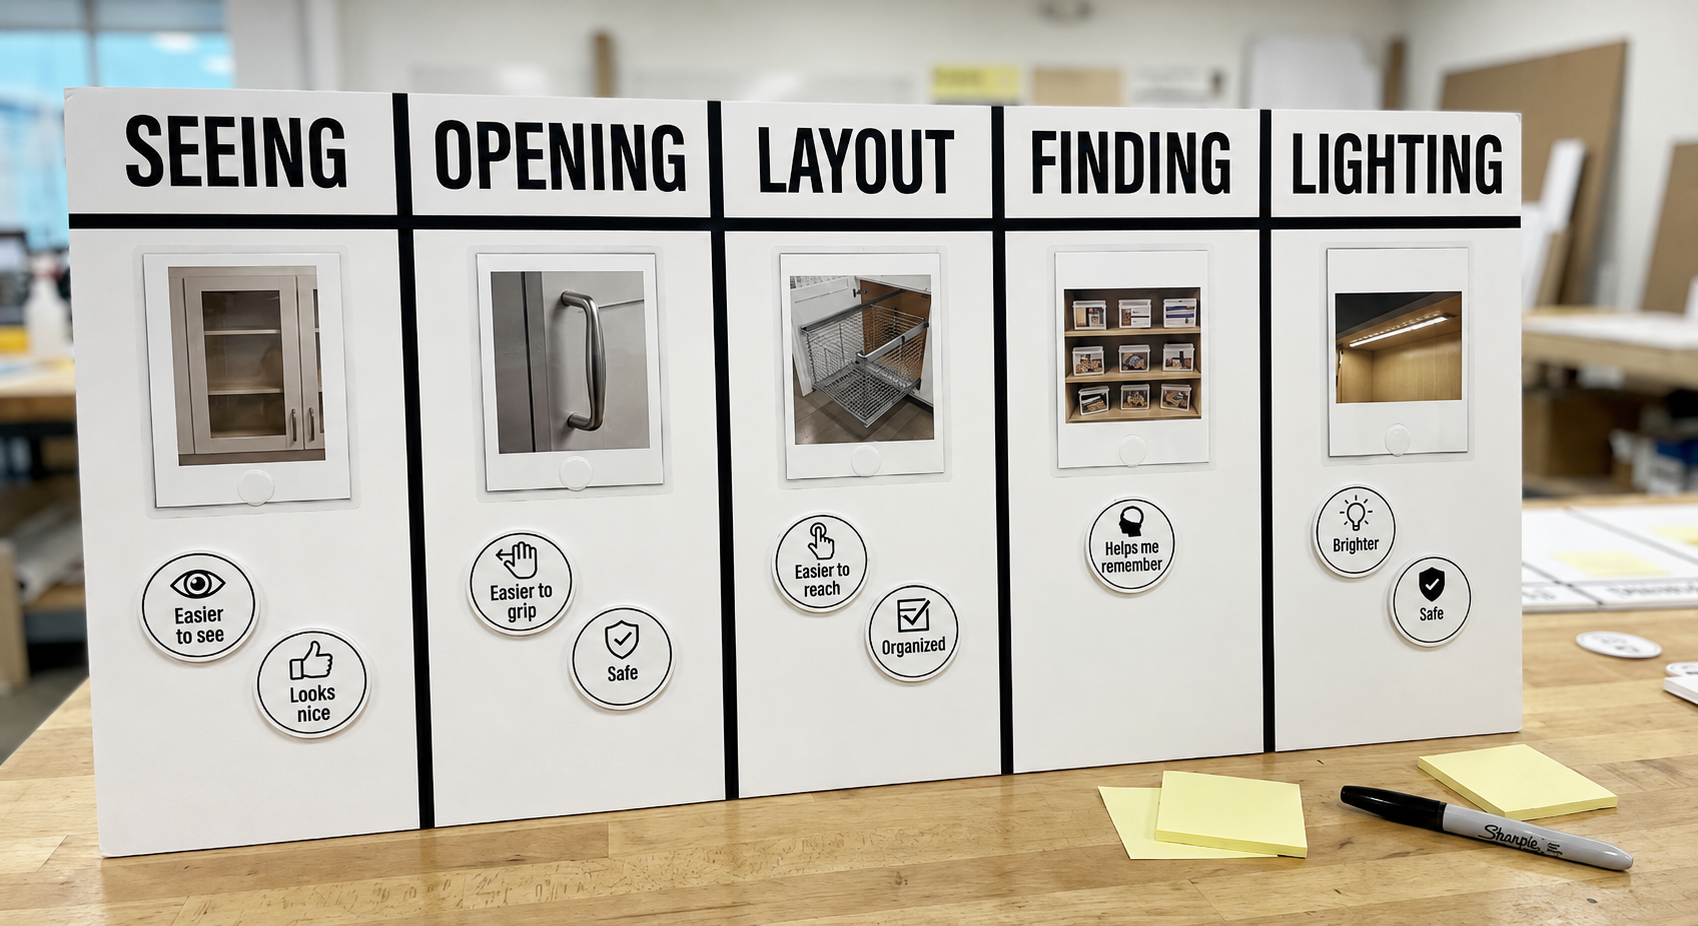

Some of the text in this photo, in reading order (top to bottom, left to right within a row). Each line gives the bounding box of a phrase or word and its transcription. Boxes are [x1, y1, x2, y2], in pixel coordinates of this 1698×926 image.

[125, 114, 347, 189] SEEING
[434, 119, 687, 193] OPENING
[758, 126, 955, 195] LAYOUT
[1031, 130, 1231, 195] FINDING
[1292, 132, 1503, 195] LIGHTING
[1105, 540, 1159, 559] Helps me
[1333, 536, 1380, 555] Brighter
[795, 562, 850, 580] Easier to
[1101, 557, 1163, 574] remember
[490, 582, 553, 602] Easier to
[804, 580, 841, 598] reach
[174, 605, 224, 625] Easier
[507, 602, 537, 623] grip
[1419, 605, 1444, 622] Safe
[175, 628, 225, 645] to see
[881, 635, 946, 658] Organized
[607, 664, 639, 682] Safe
[290, 684, 336, 704] Looks
[297, 704, 331, 723] nice
